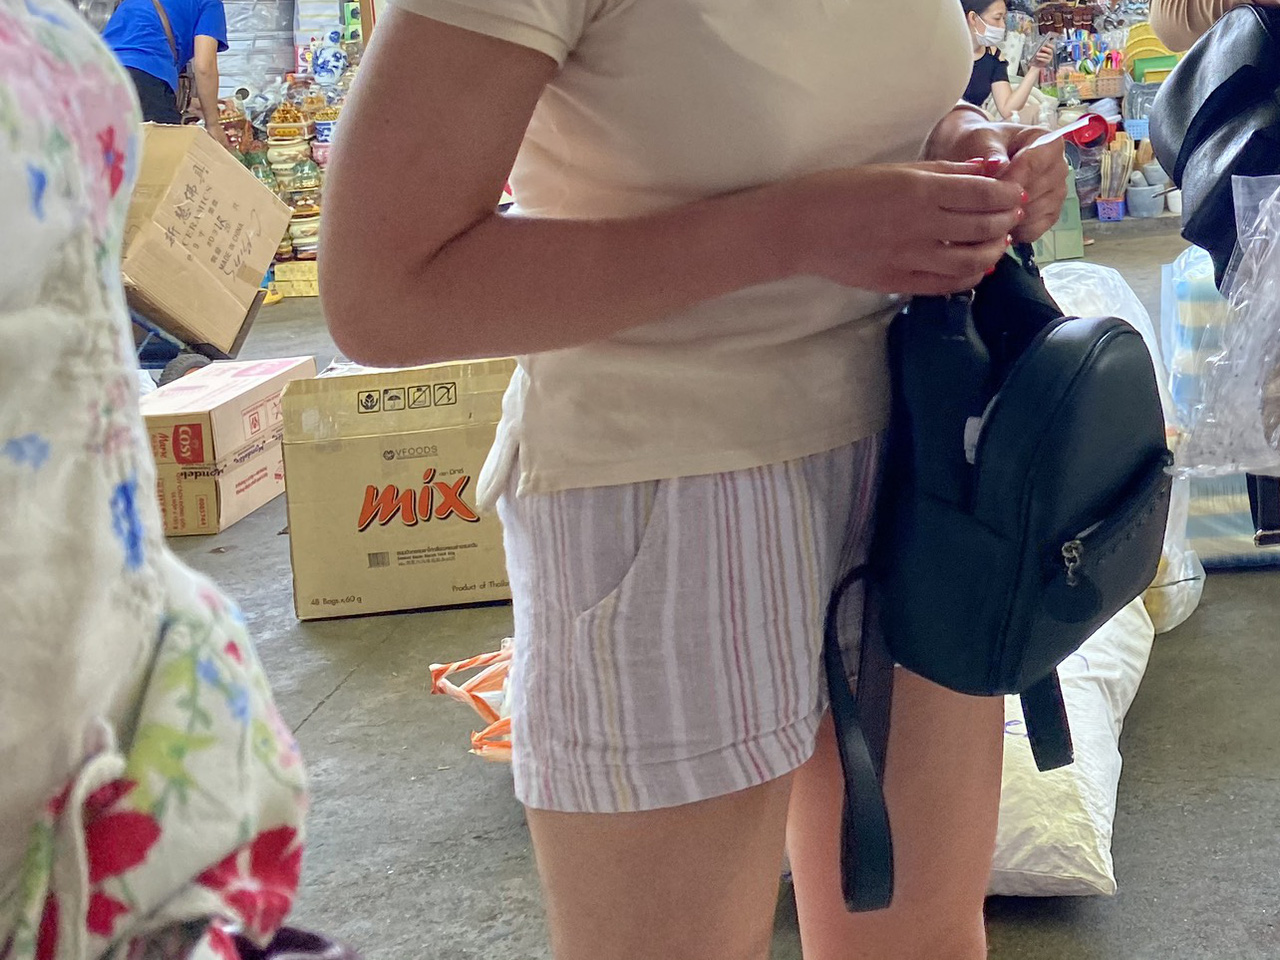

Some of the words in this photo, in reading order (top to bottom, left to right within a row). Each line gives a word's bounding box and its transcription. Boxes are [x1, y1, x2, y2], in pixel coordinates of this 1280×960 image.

[218, 251, 232, 271] MADE
[231, 222, 245, 243] CHINA
[178, 426, 192, 461] COSY
[357, 467, 480, 532] mix
